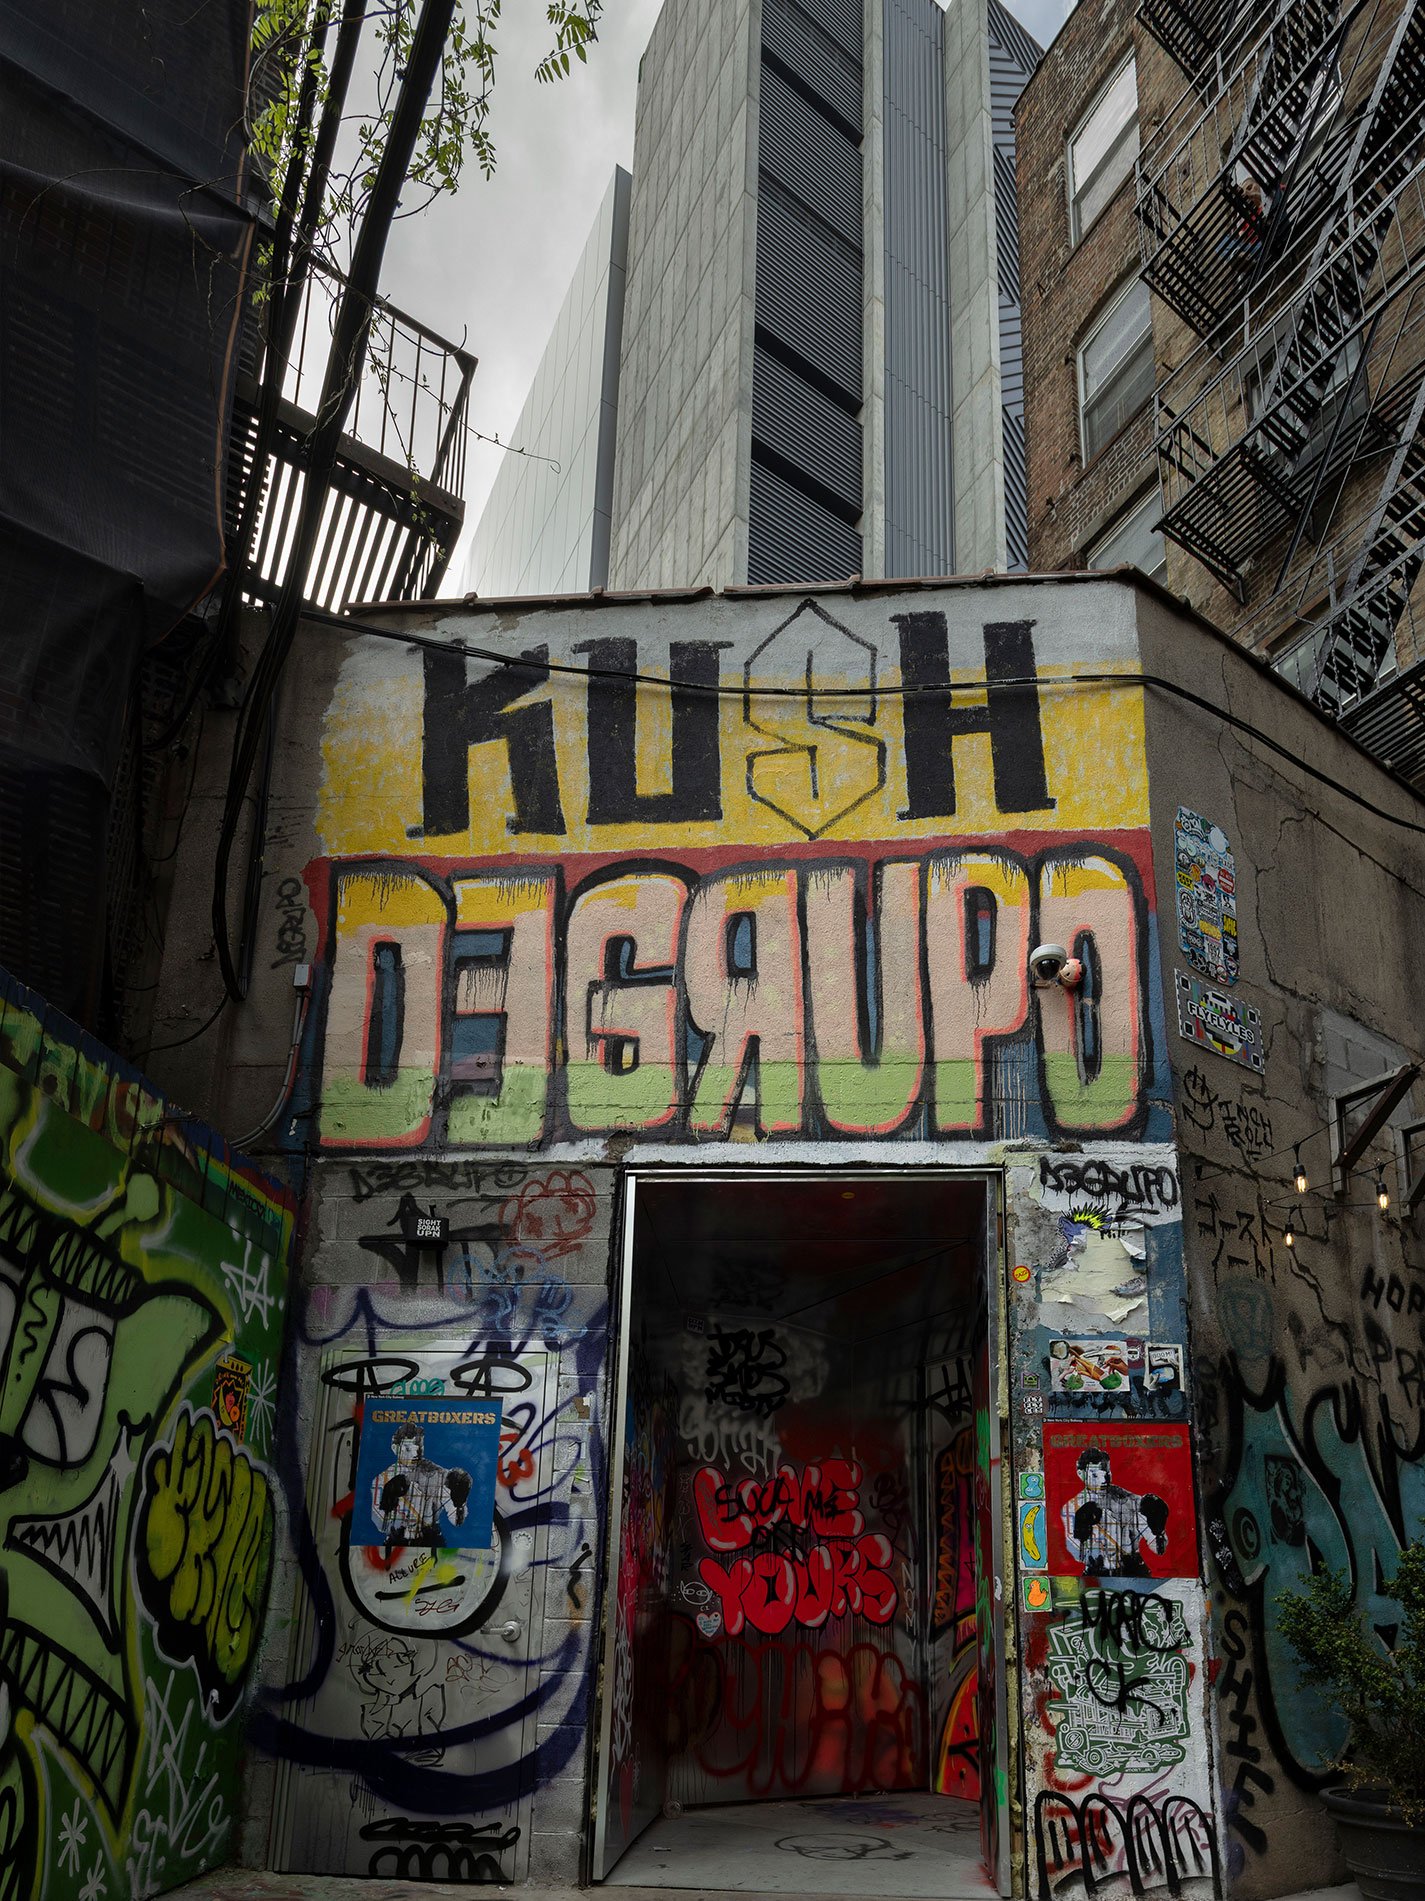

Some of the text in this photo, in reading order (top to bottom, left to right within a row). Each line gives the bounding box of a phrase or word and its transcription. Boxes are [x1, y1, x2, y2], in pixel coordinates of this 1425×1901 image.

[406, 597, 1057, 841] KUSH
[1187, 1000, 1255, 1044] FLYFLYLES
[1218, 1101, 1272, 1137] INCH
[416, 1230, 441, 1238] UPN
[417, 1218, 442, 1226] SIGHT
[371, 1409, 496, 1426] GREATBOXERS
[1050, 1434, 1184, 1449] GREATBOXERS
[698, 1532, 899, 1637] YOURS
